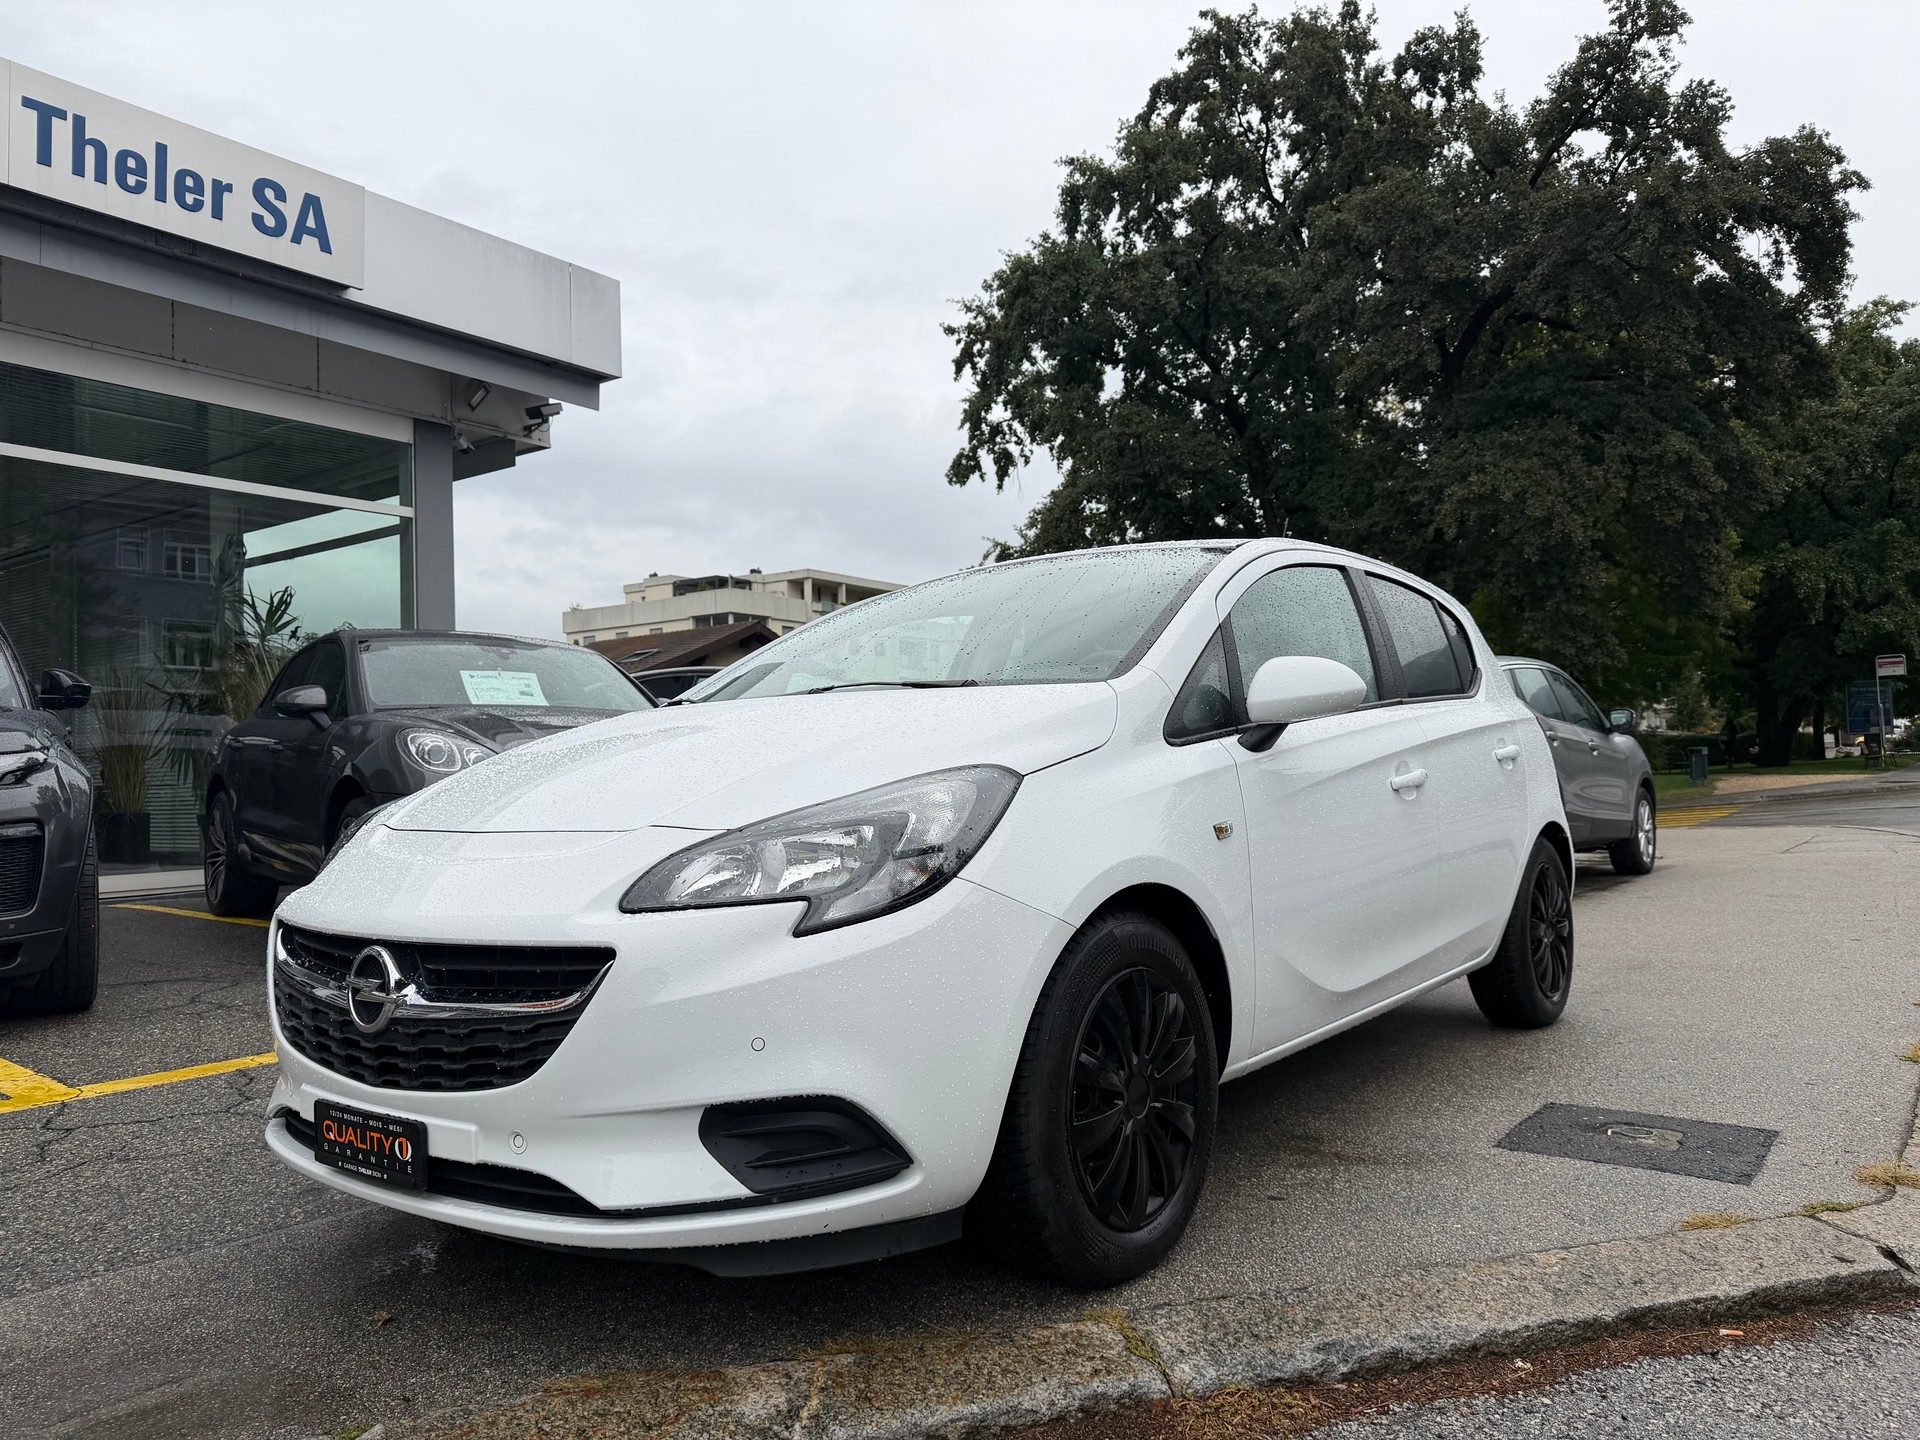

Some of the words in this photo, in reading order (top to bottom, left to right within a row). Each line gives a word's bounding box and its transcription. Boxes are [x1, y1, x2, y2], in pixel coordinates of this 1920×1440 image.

[21, 95, 233, 221] Theler
[251, 177, 333, 255] SA
[343, 1113, 363, 1124] MONATE
[368, 1119, 383, 1129] MOIS
[388, 1124, 403, 1133] MESI
[324, 1143, 412, 1174] GARANTIE
